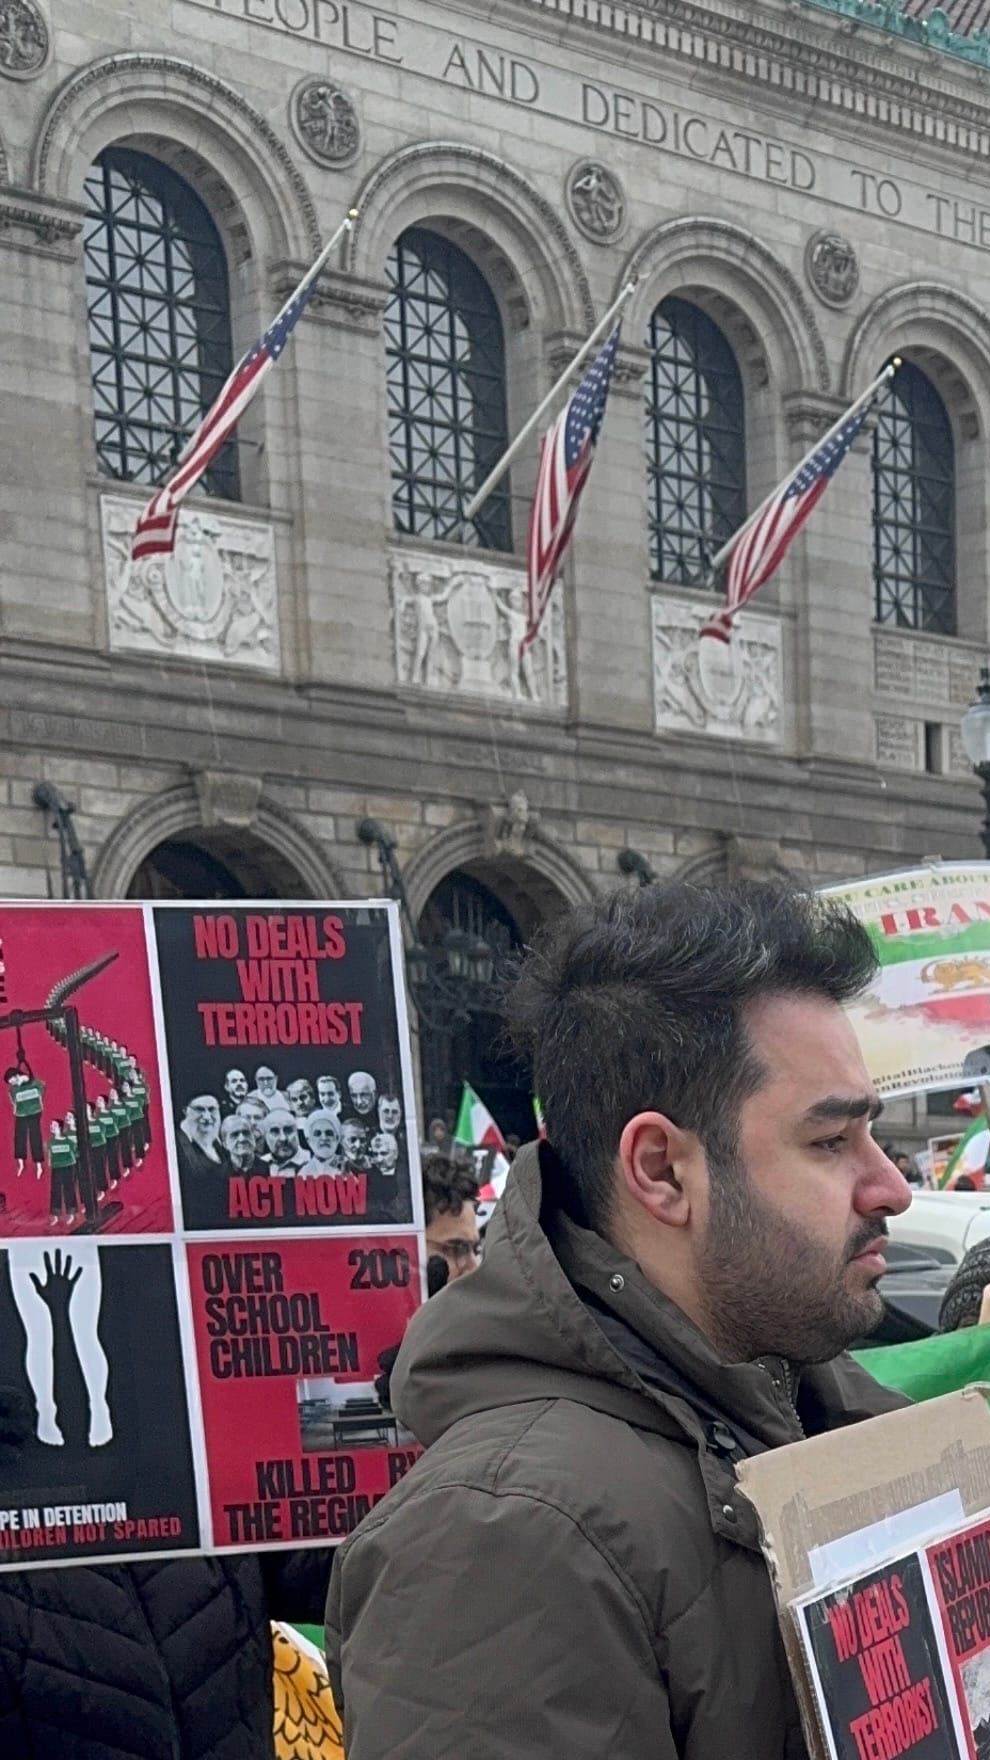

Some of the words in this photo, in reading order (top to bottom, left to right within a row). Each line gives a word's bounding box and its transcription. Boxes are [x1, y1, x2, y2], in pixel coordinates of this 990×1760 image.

[215, 0, 403, 63] OPLE
[442, 43, 540, 103] AND
[581, 82, 817, 191] DEDICATED
[850, 169, 902, 217] TO
[193, 914, 240, 959] NO
[246, 914, 346, 959] DEALS
[236, 960, 320, 1002] WITH
[197, 1002, 363, 1046] TERRORIST
[228, 1176, 287, 1218] ACT
[294, 1173, 369, 1217] NOW
[202, 1251, 284, 1296] OVER
[348, 1248, 410, 1290] 200
[205, 1292, 330, 1337] SCHOOL
[210, 1332, 361, 1379] CHILDREN
[255, 1455, 357, 1501] KILLED
[22, 1508, 40, 1529] IN
[43, 1502, 128, 1528] DETENTION
[73, 1523, 107, 1544] NOT
[113, 1516, 182, 1541] SPARED
[223, 1502, 283, 1542] THE
[828, 1602, 858, 1662] NO
[852, 1573, 911, 1647] DEALS
[858, 1633, 912, 1706] WITH
